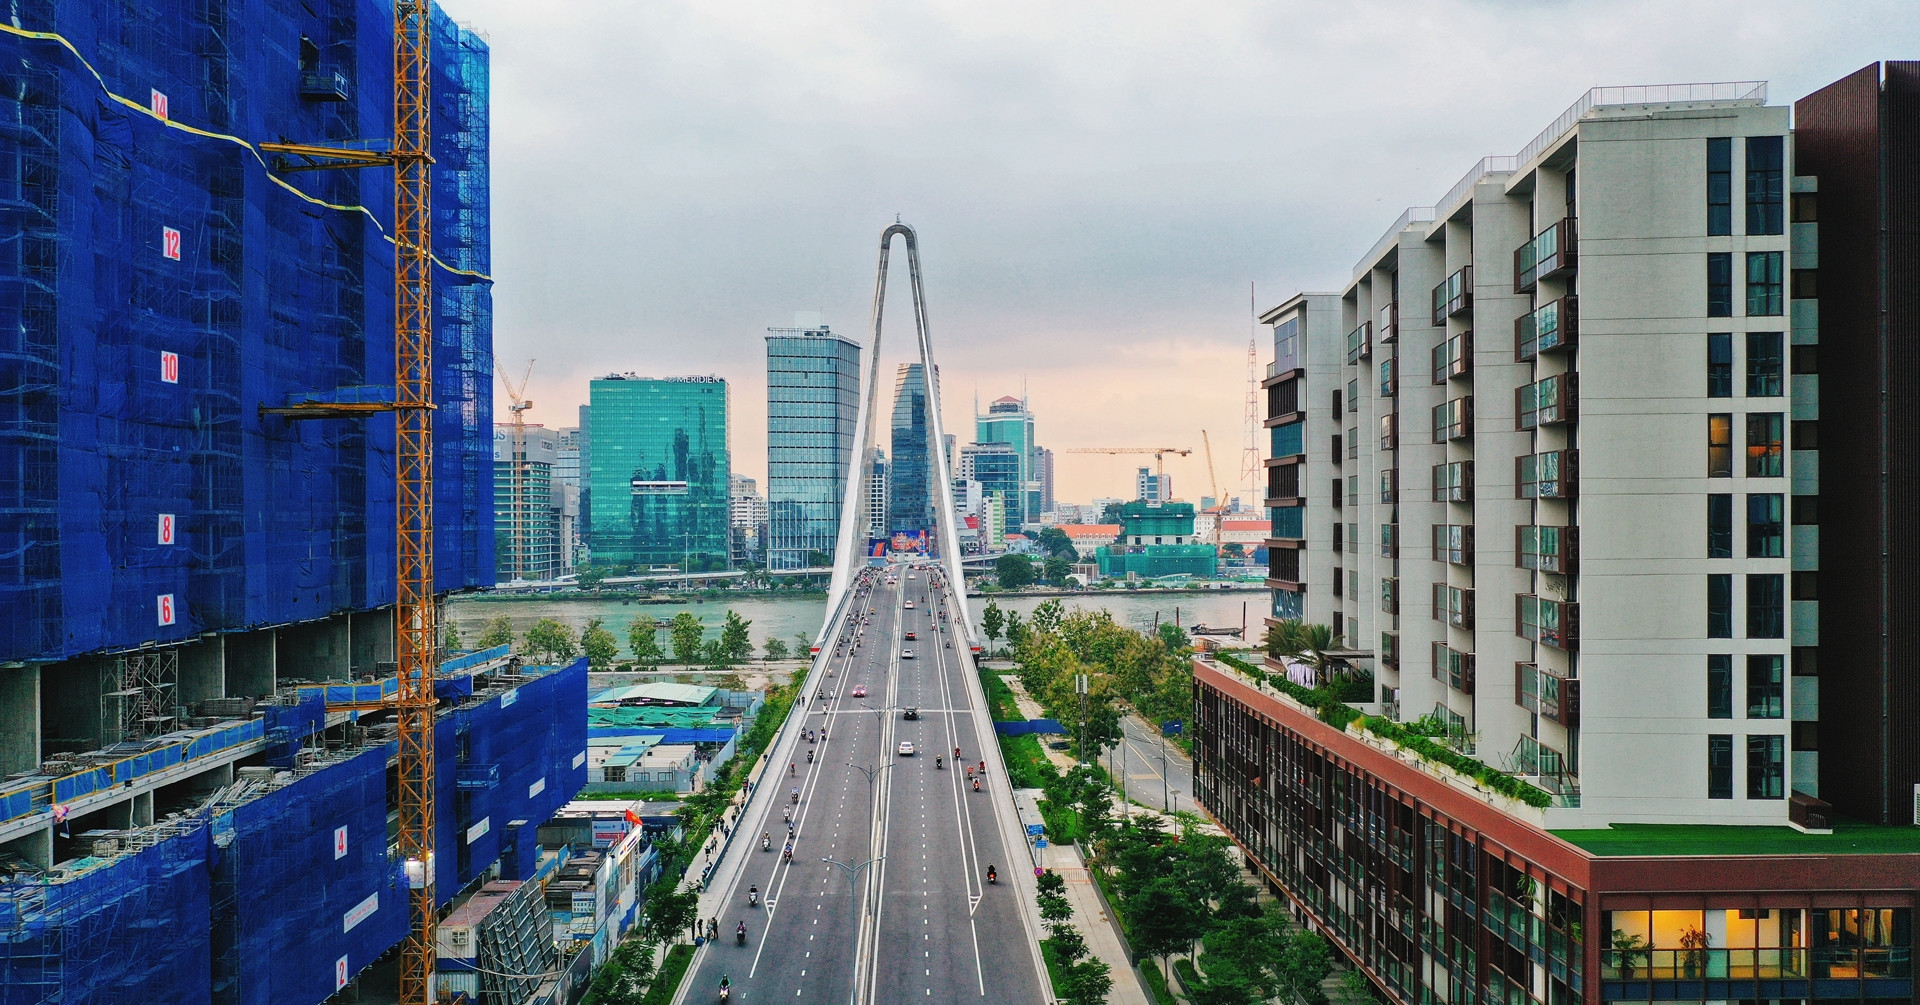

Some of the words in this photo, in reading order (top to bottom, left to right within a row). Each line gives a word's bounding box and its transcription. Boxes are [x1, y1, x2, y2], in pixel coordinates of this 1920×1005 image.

[153, 93, 166, 119] 14
[165, 230, 179, 259] 12
[163, 354, 178, 382] 10
[163, 516, 171, 543] 8
[162, 596, 171, 623] 6
[338, 830, 345, 853] 4
[339, 961, 345, 985] 2
